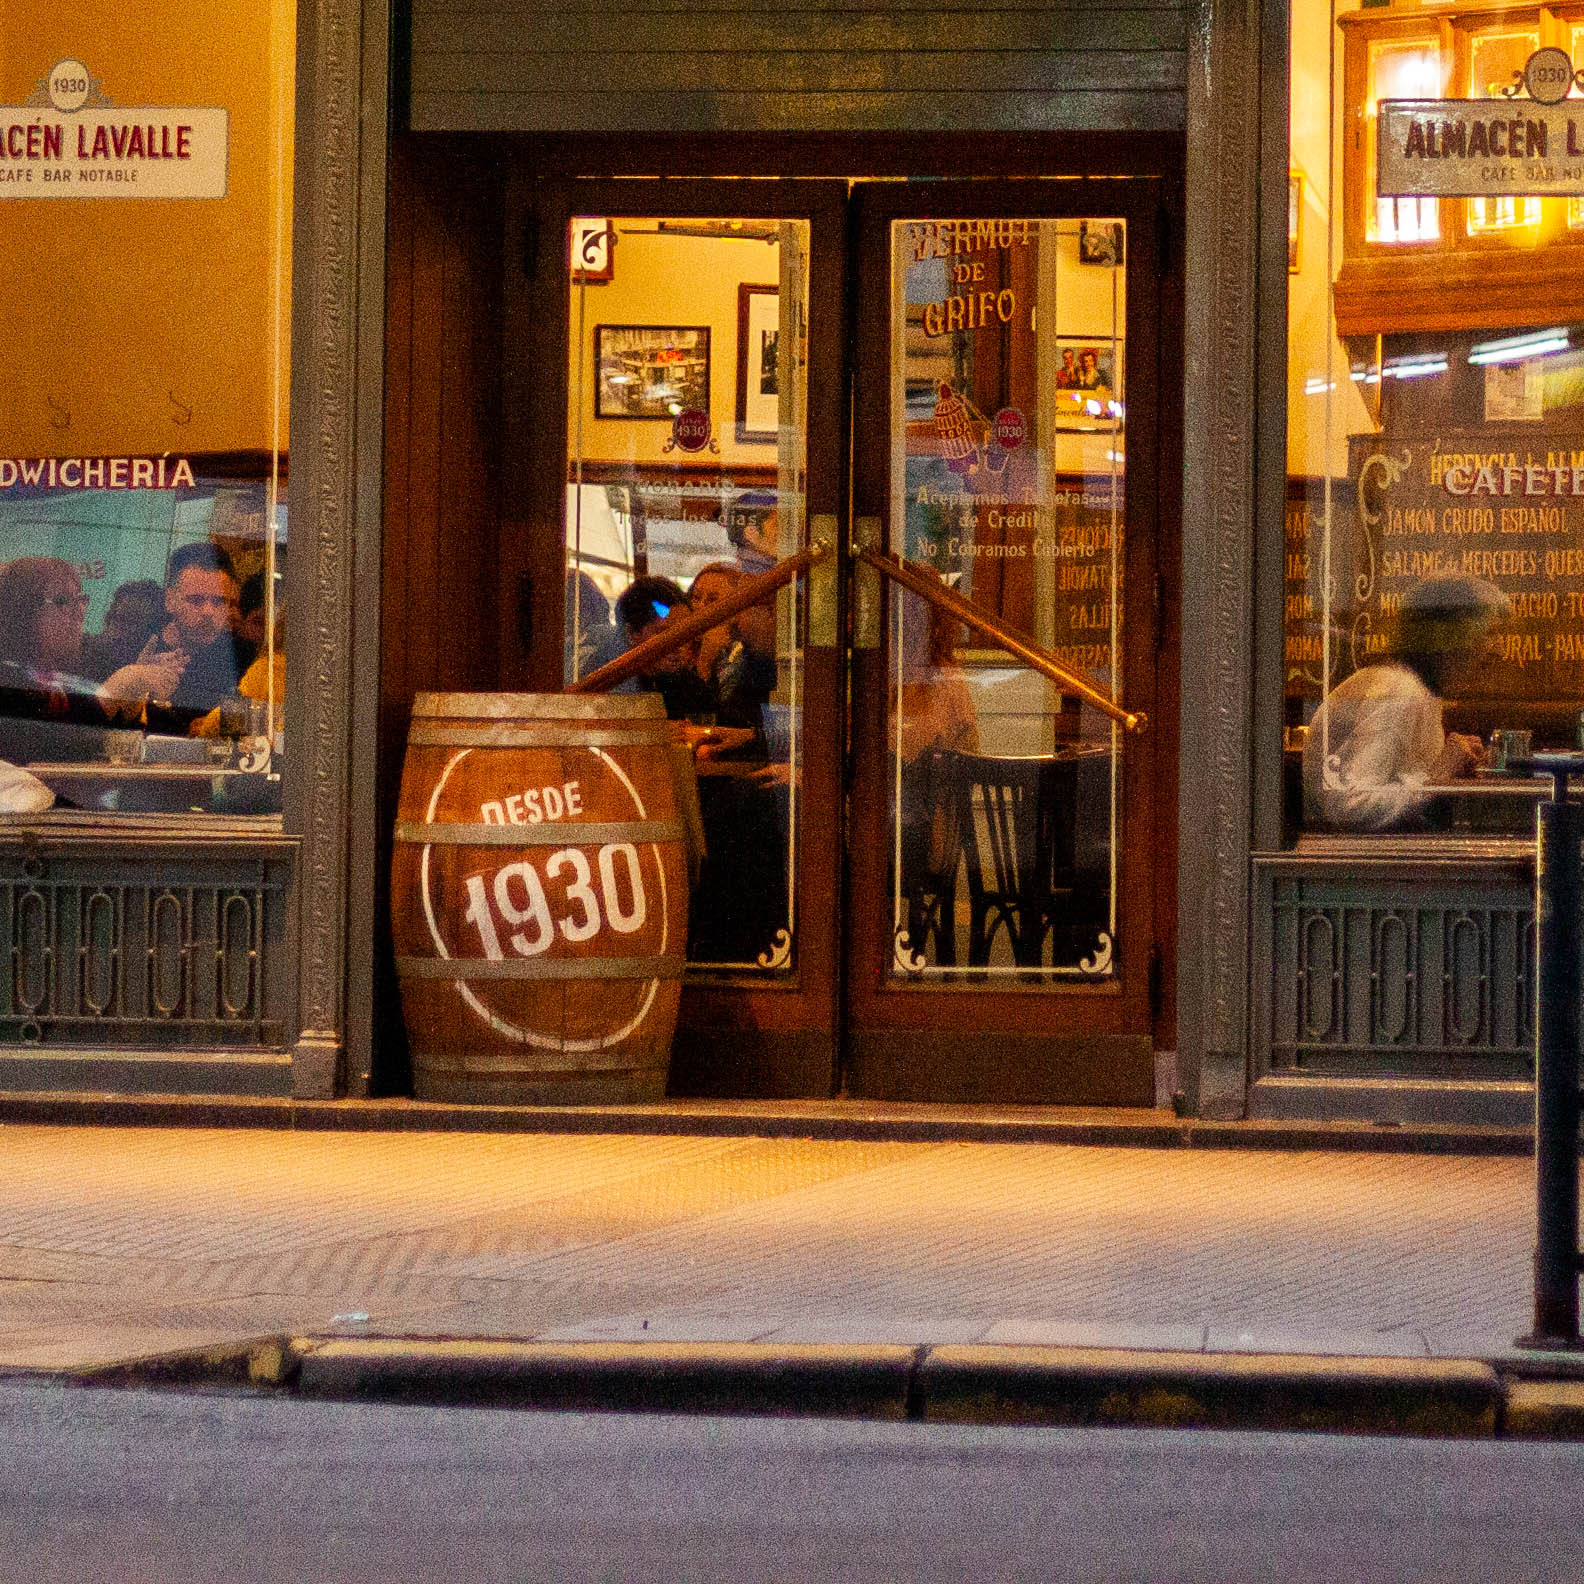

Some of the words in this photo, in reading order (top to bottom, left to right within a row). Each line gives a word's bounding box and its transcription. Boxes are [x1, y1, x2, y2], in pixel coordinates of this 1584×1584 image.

[52, 77, 87, 95] 1930
[77, 124, 193, 161] LAVALLE
[1404, 110, 1548, 161] ALMACÉN
[43, 168, 72, 183] BAR
[78, 168, 138, 183] NOTABLE
[1525, 165, 1555, 181] BAR
[909, 219, 1031, 262] VERMUT
[954, 261, 986, 285] DE
[922, 286, 1016, 339] GRIFO
[677, 424, 706, 438] 1930
[997, 425, 1023, 439] 1930
[1442, 506, 1495, 537] CRUDO
[1500, 500, 1569, 535] ESPAÑOL
[916, 537, 939, 557] No
[947, 537, 1027, 558] Cobramos
[1382, 548, 1443, 577] SALAME
[1461, 547, 1538, 579] MERCEDES
[479, 779, 583, 829] DESDE
[465, 841, 647, 962] 1930
